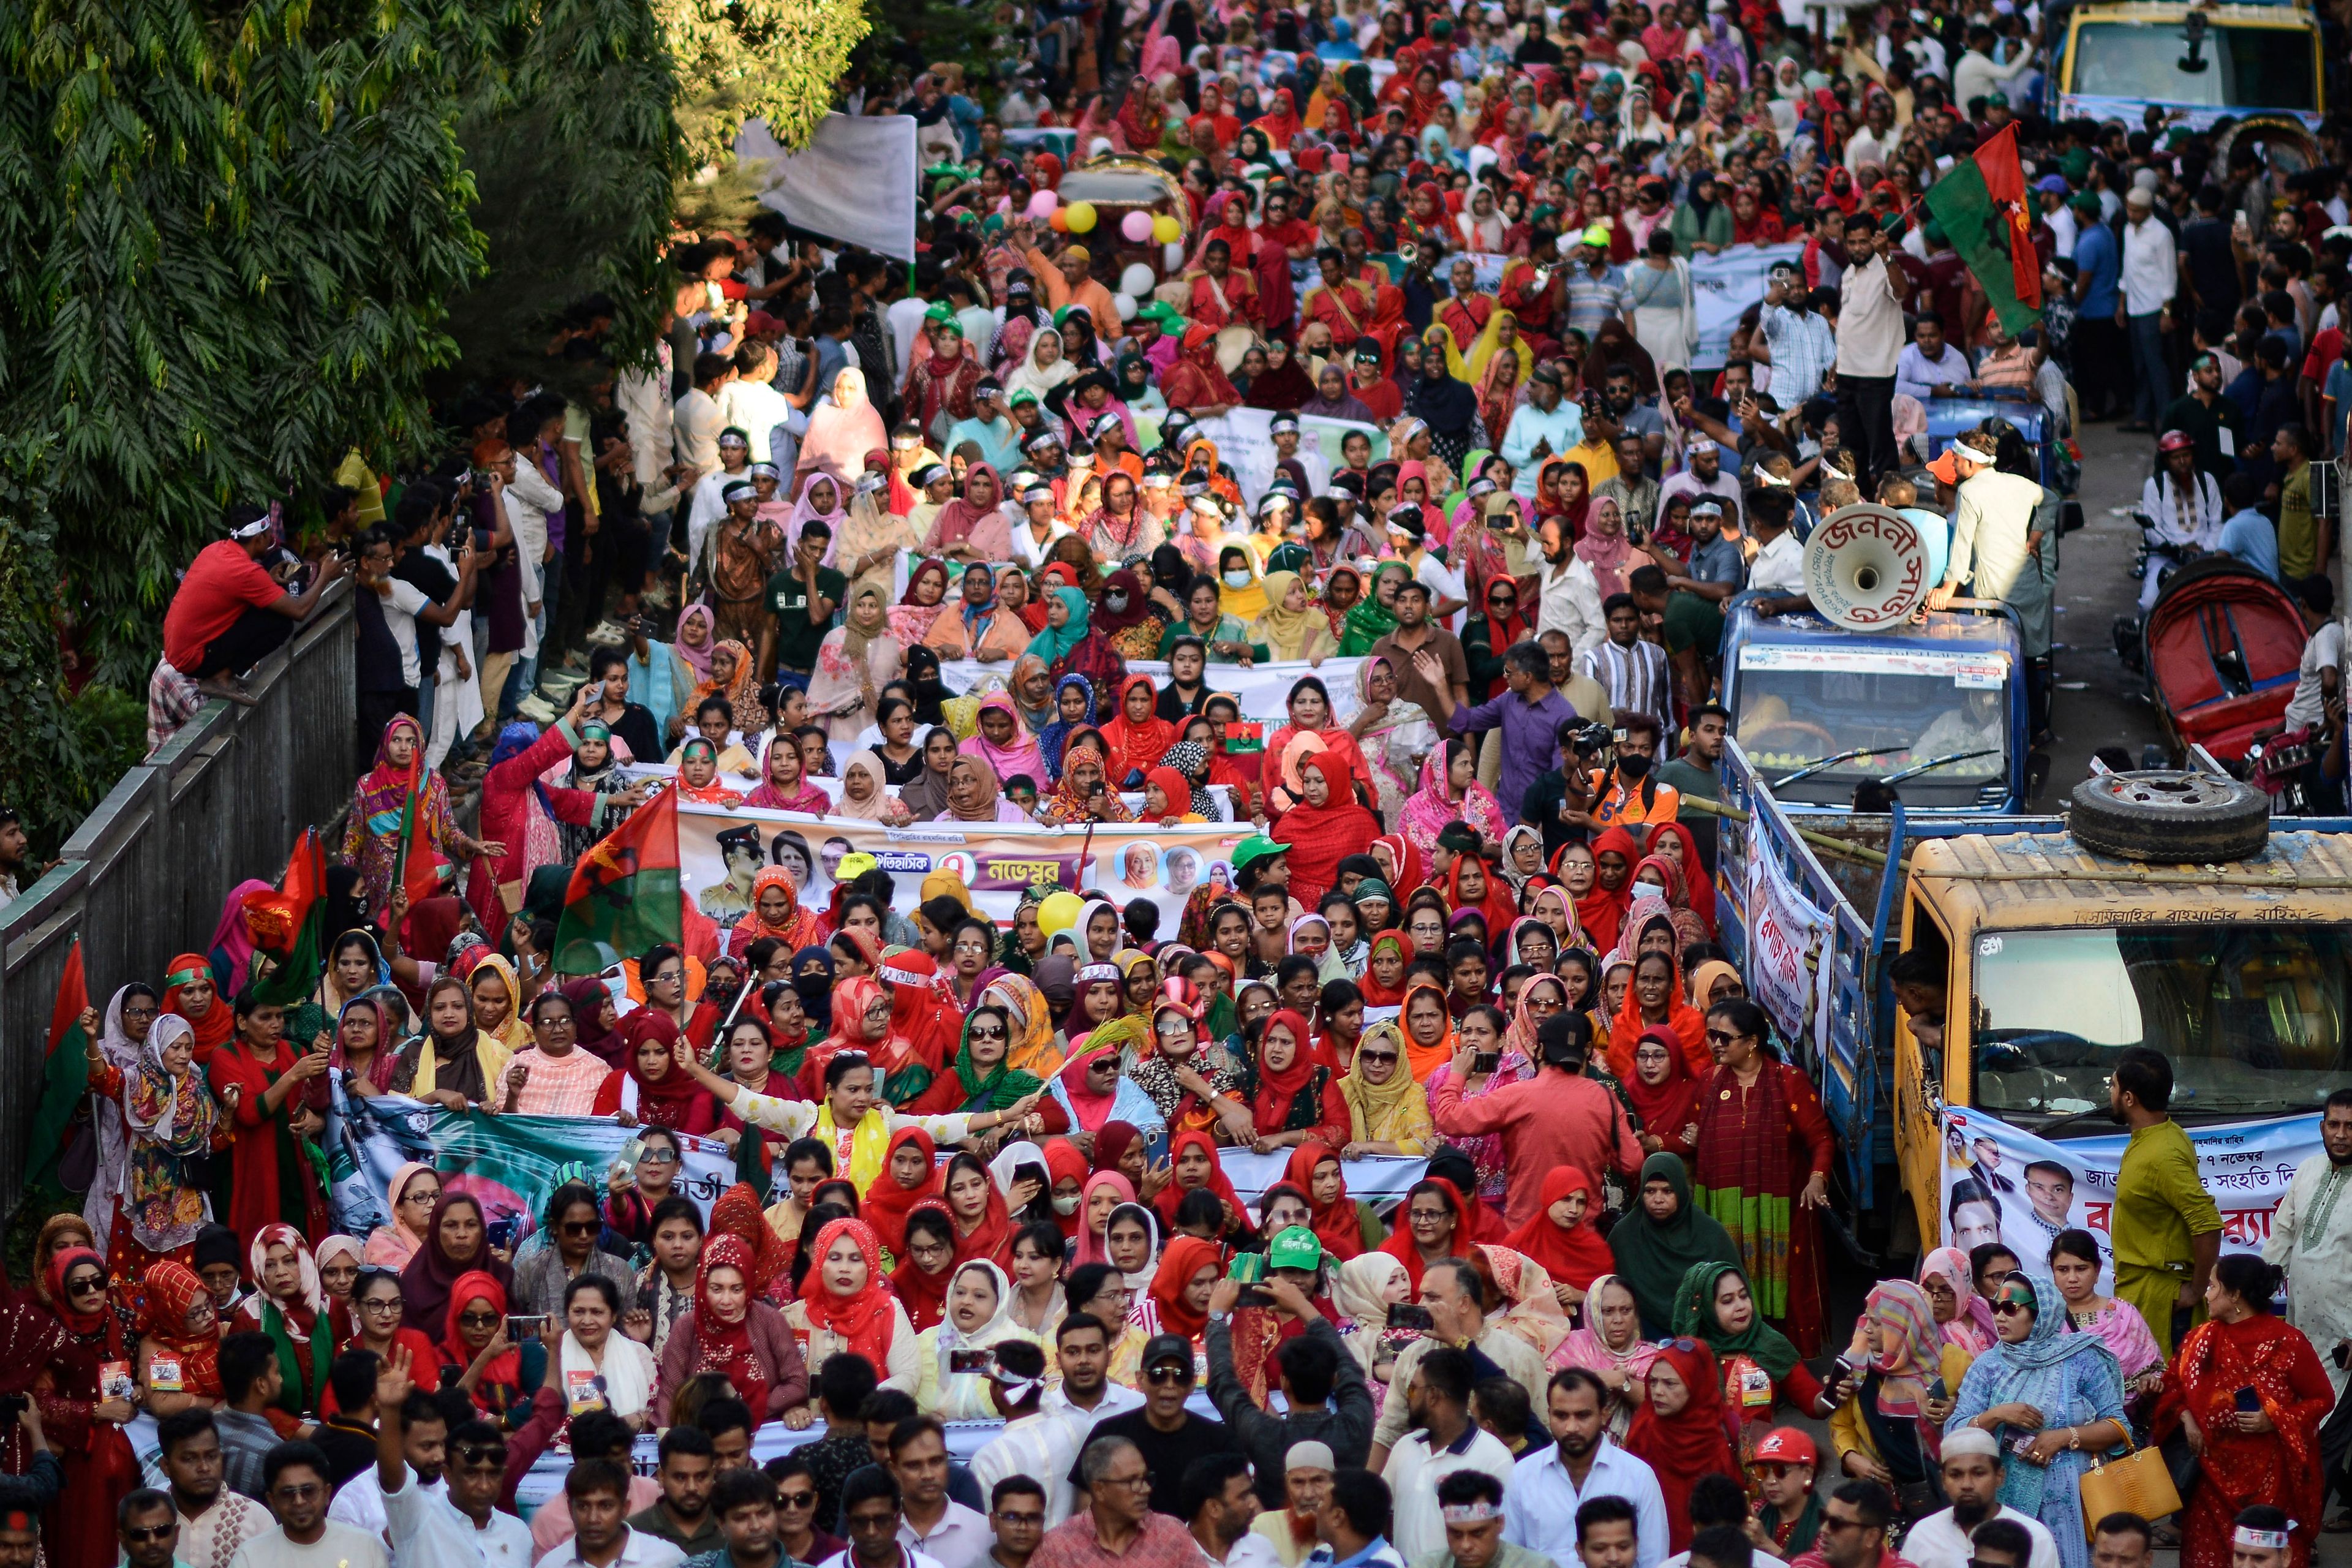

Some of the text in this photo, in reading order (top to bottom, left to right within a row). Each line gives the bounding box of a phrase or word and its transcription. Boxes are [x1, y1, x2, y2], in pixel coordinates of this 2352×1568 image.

[1819, 513, 1918, 558] জননী
[1812, 546, 1842, 615] 01857404090
[1600, 801, 1616, 821] 5
[988, 860, 1060, 884] নভেম্বর
[2207, 1150, 2264, 1167] ৭ নভেম্বর
[2214, 1165, 2271, 1191] সংহতি
